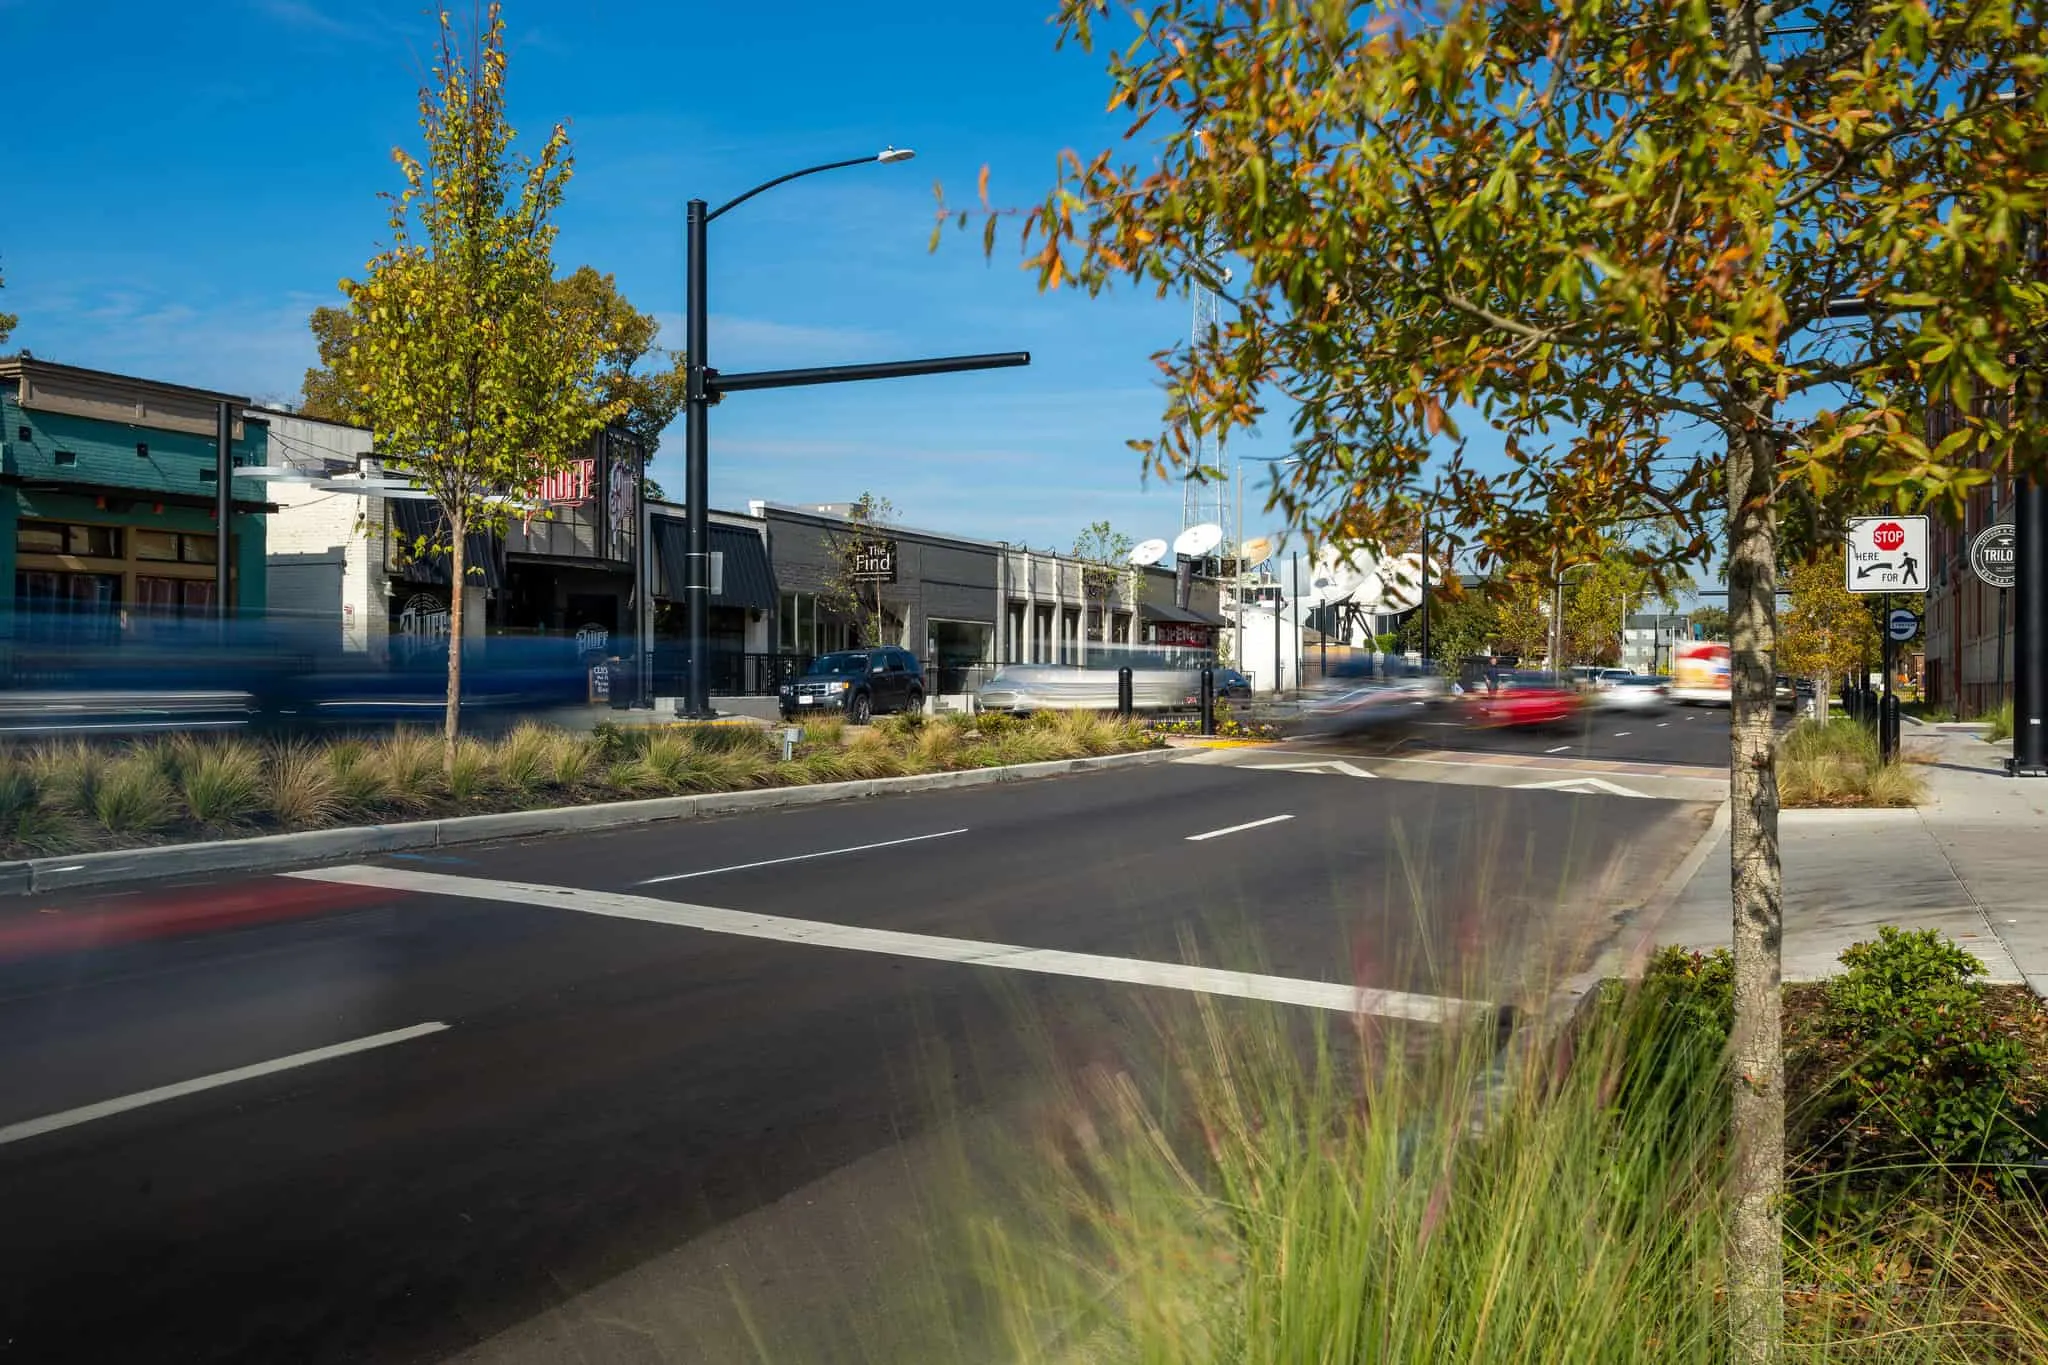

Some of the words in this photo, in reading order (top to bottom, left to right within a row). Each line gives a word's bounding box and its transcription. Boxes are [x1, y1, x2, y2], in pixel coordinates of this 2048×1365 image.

[1874, 530, 1904, 543] STOP
[868, 545, 886, 555] The
[856, 553, 890, 570] Find
[1856, 552, 1880, 561] HERE
[1881, 573, 1898, 582] FOR
